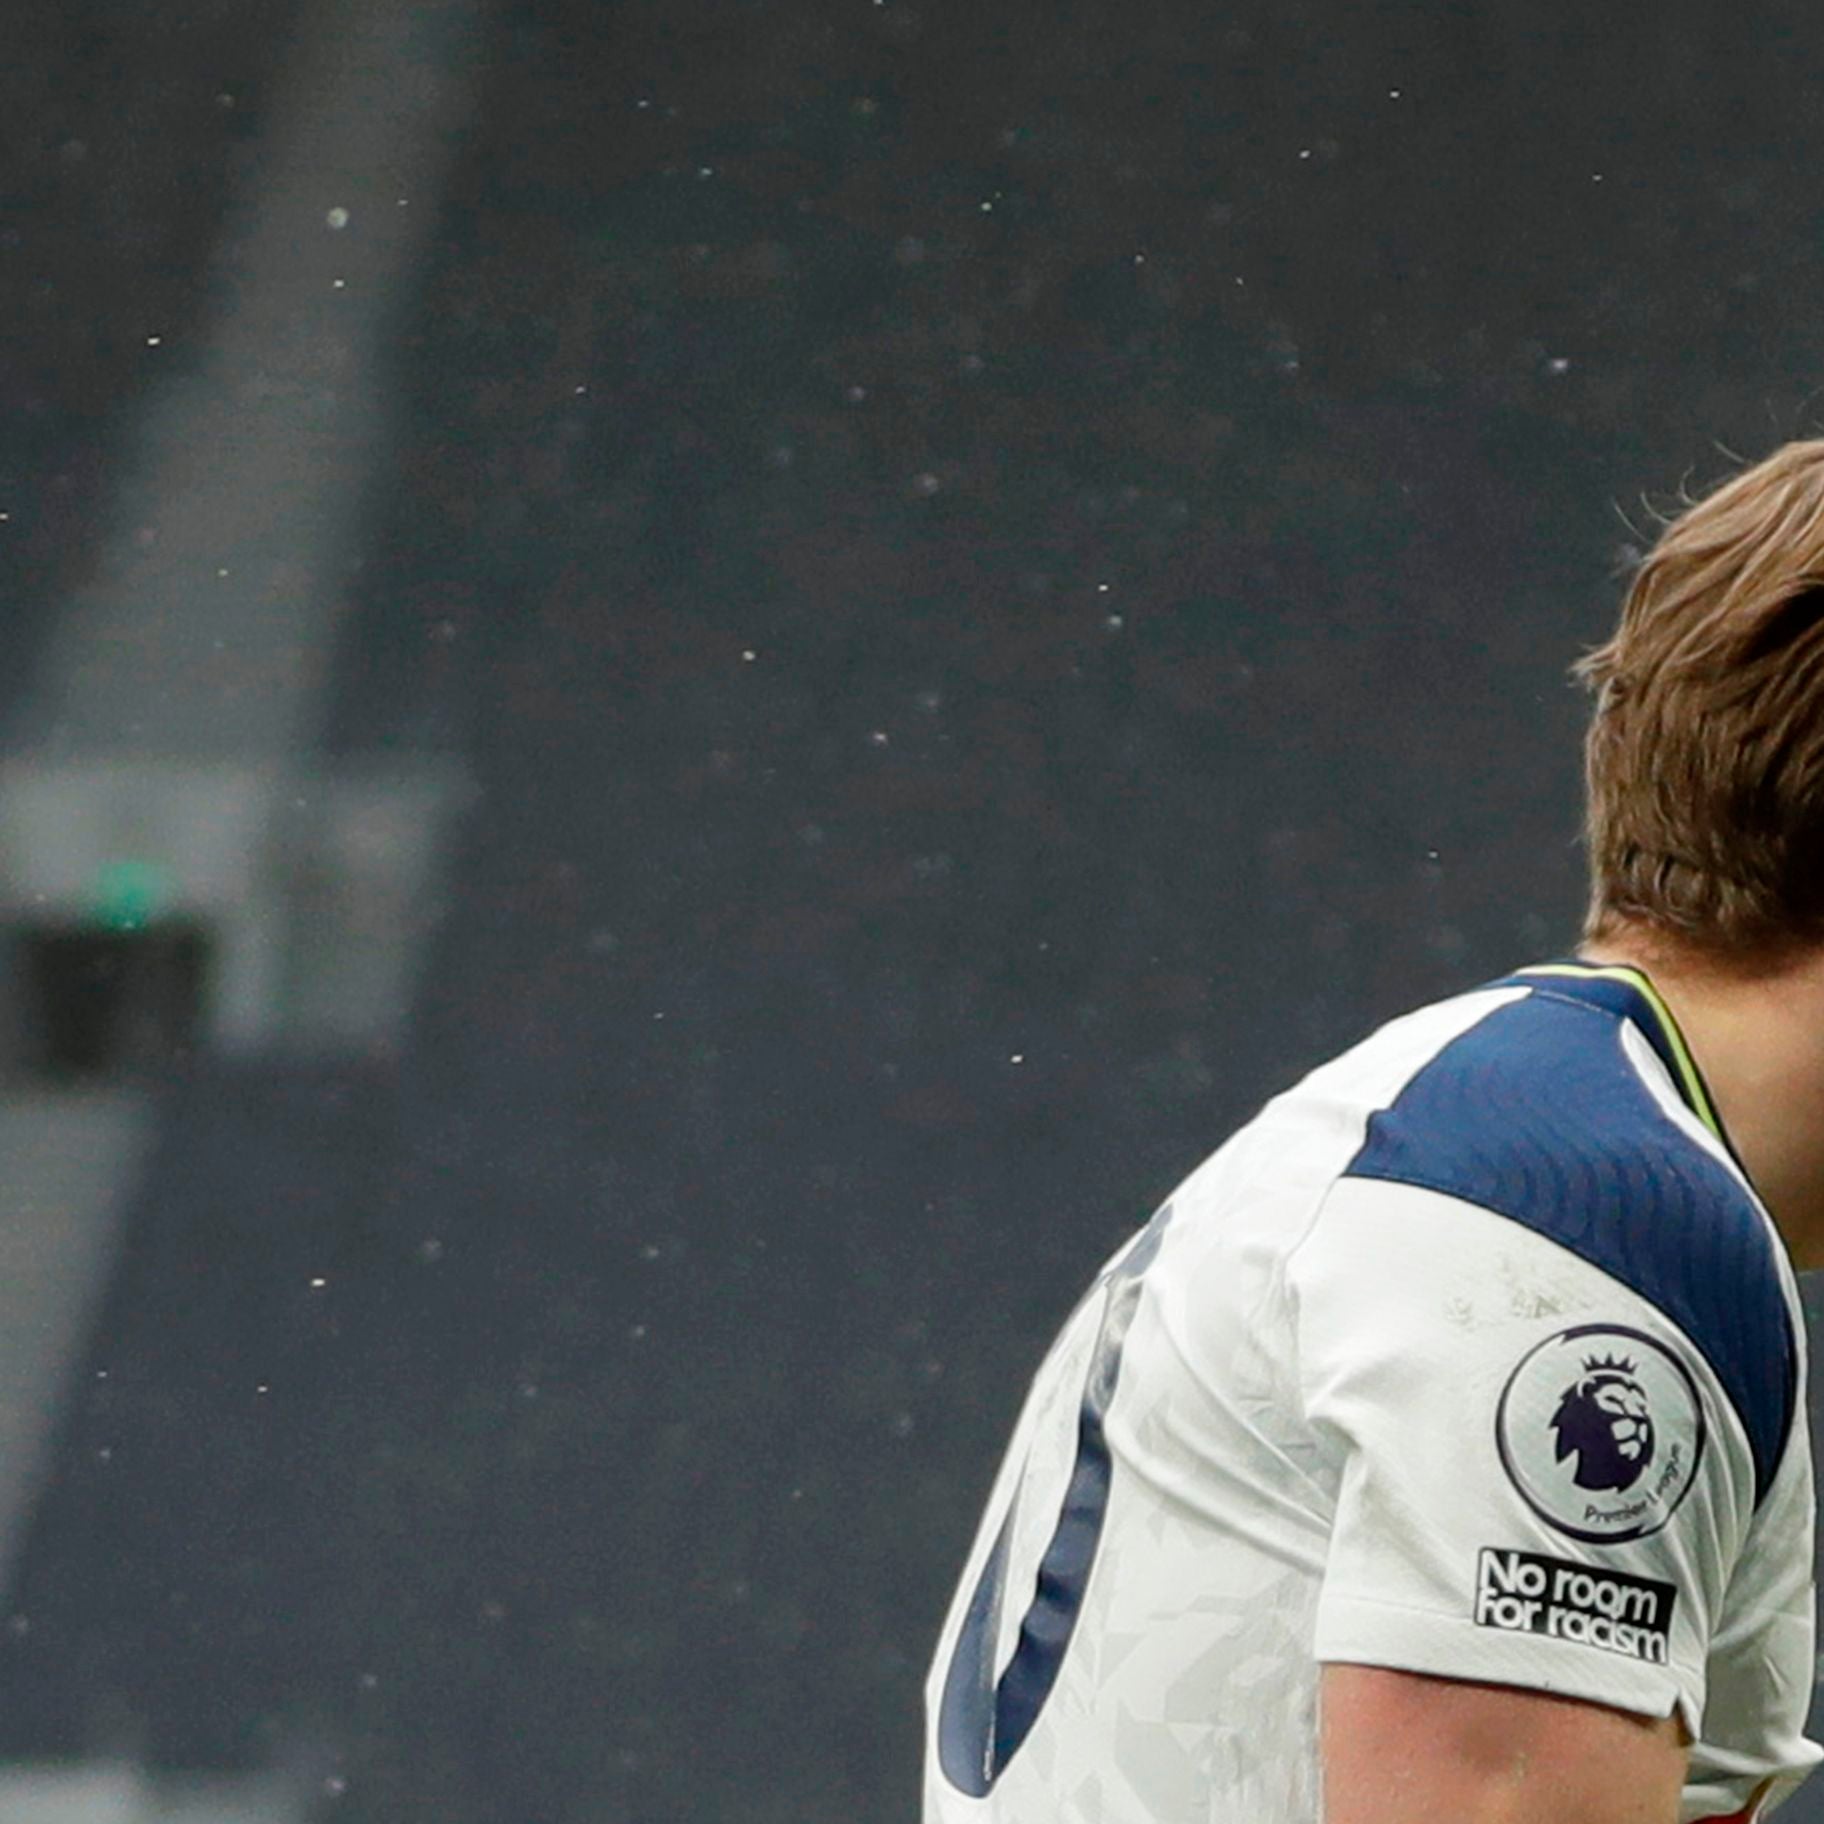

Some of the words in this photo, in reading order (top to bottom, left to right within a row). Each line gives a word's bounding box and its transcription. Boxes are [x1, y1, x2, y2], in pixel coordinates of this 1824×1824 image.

[1476, 1586, 1542, 1631] for
[1547, 1604, 1668, 1664] racism
[1479, 1548, 1547, 1598] No
[1553, 1568, 1658, 1625] room
